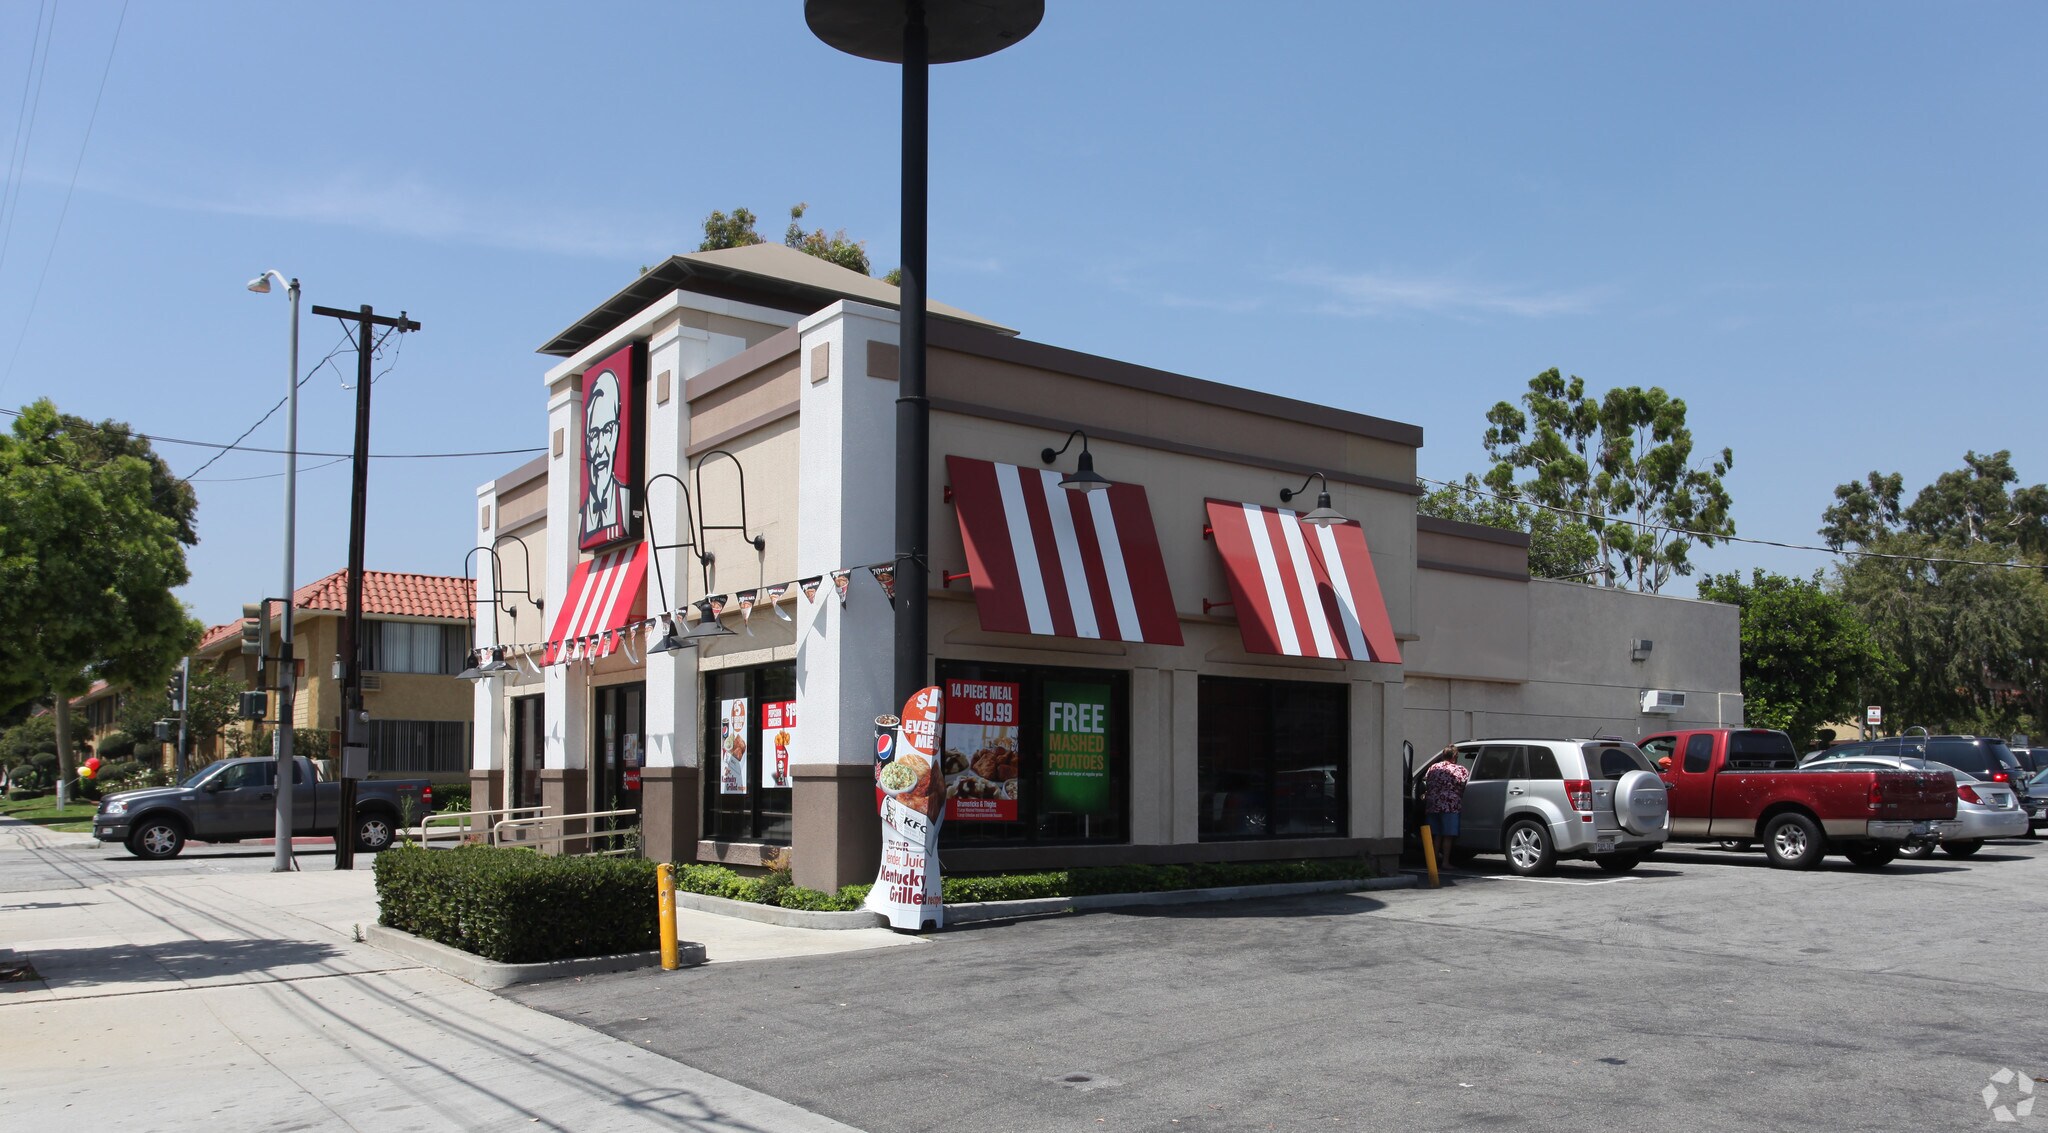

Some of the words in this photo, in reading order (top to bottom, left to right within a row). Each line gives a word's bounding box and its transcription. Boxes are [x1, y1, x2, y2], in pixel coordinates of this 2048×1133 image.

[951, 683, 961, 697] 14
[963, 684, 988, 699] PIECE
[990, 686, 1012, 700] MEAL
[975, 701, 1012, 722] $19.99
[1049, 701, 1104, 733] FREE
[1049, 733, 1104, 753] MASHED
[1049, 753, 1104, 770] POTATOES
[904, 817, 928, 834] KFC
[881, 865, 927, 891] Kentucky
[889, 885, 927, 905] Grilled
